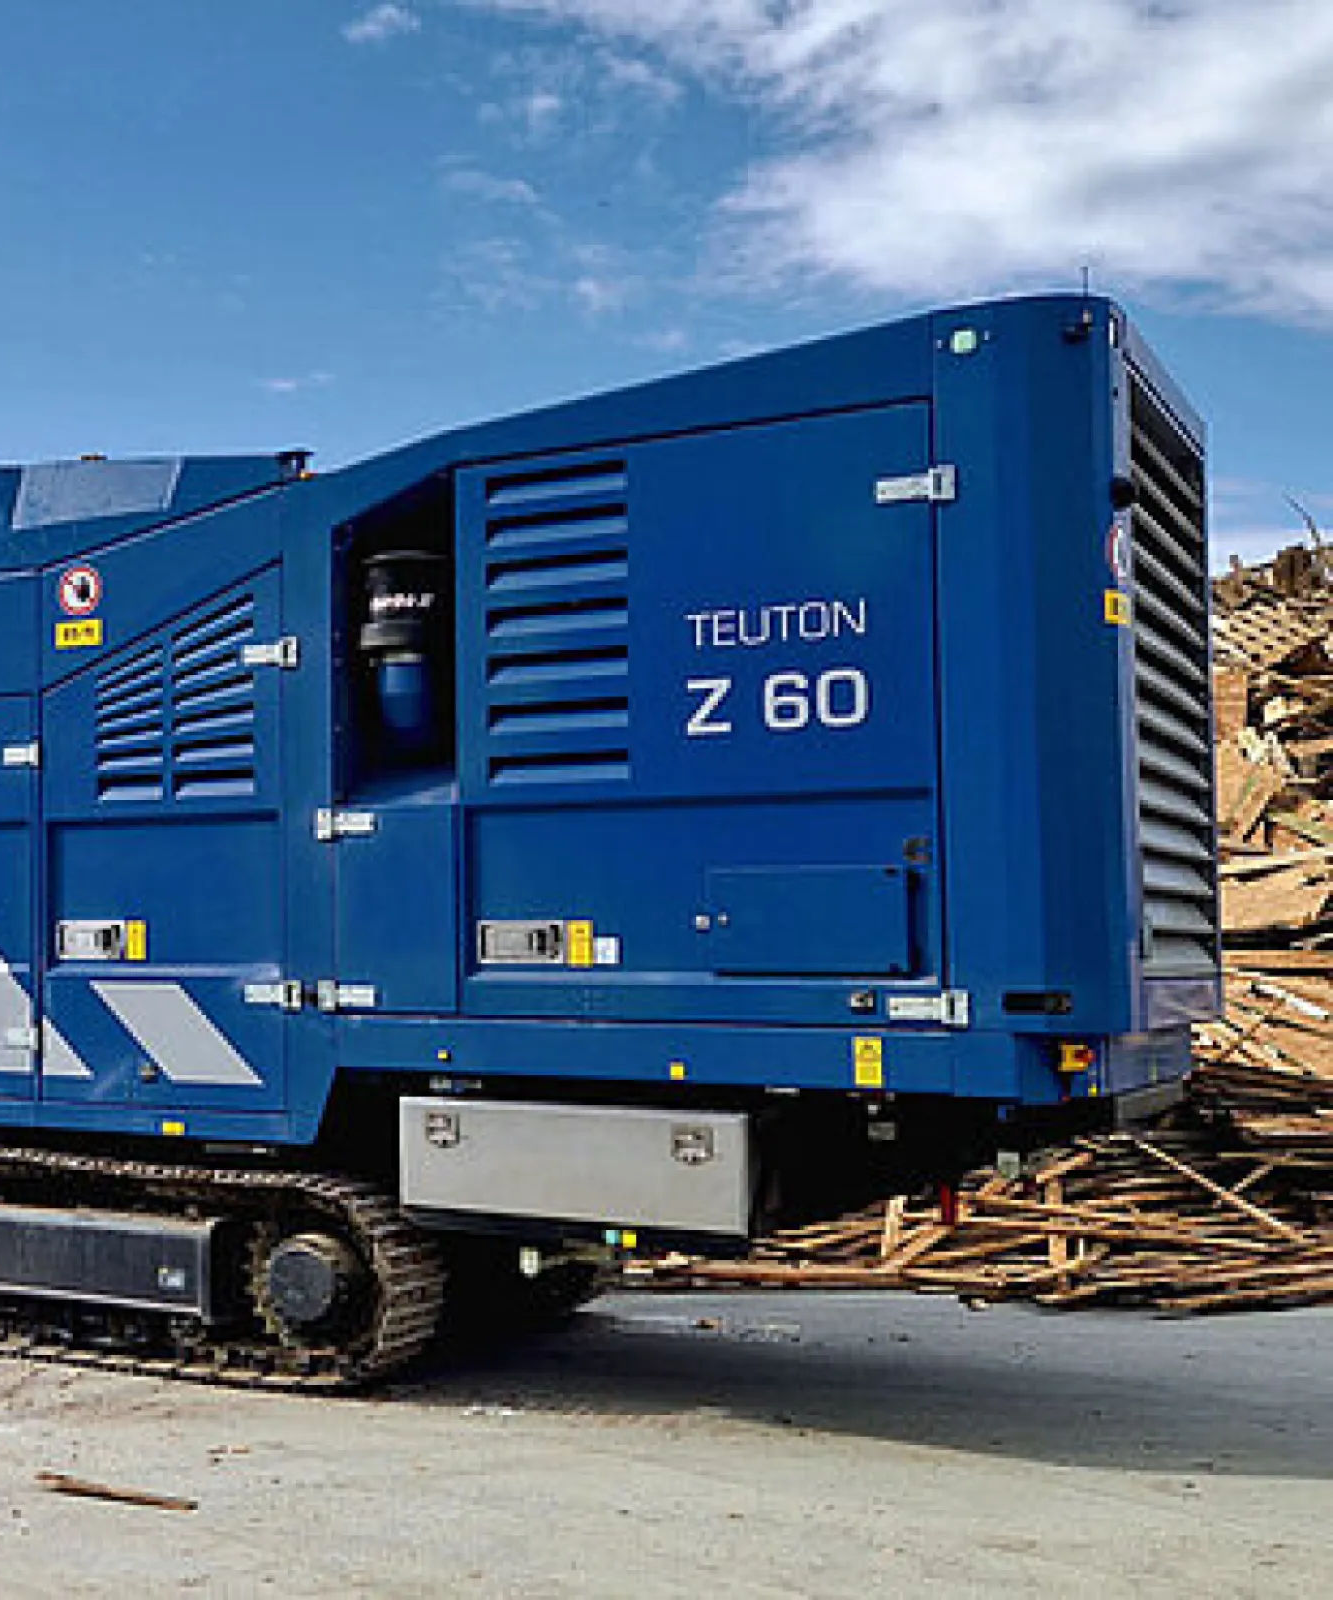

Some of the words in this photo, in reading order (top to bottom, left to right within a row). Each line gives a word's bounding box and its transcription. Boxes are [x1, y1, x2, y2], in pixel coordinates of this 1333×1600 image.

[683, 598, 866, 647] TEUTON
[687, 677, 732, 736] Z
[764, 668, 869, 730] 60
